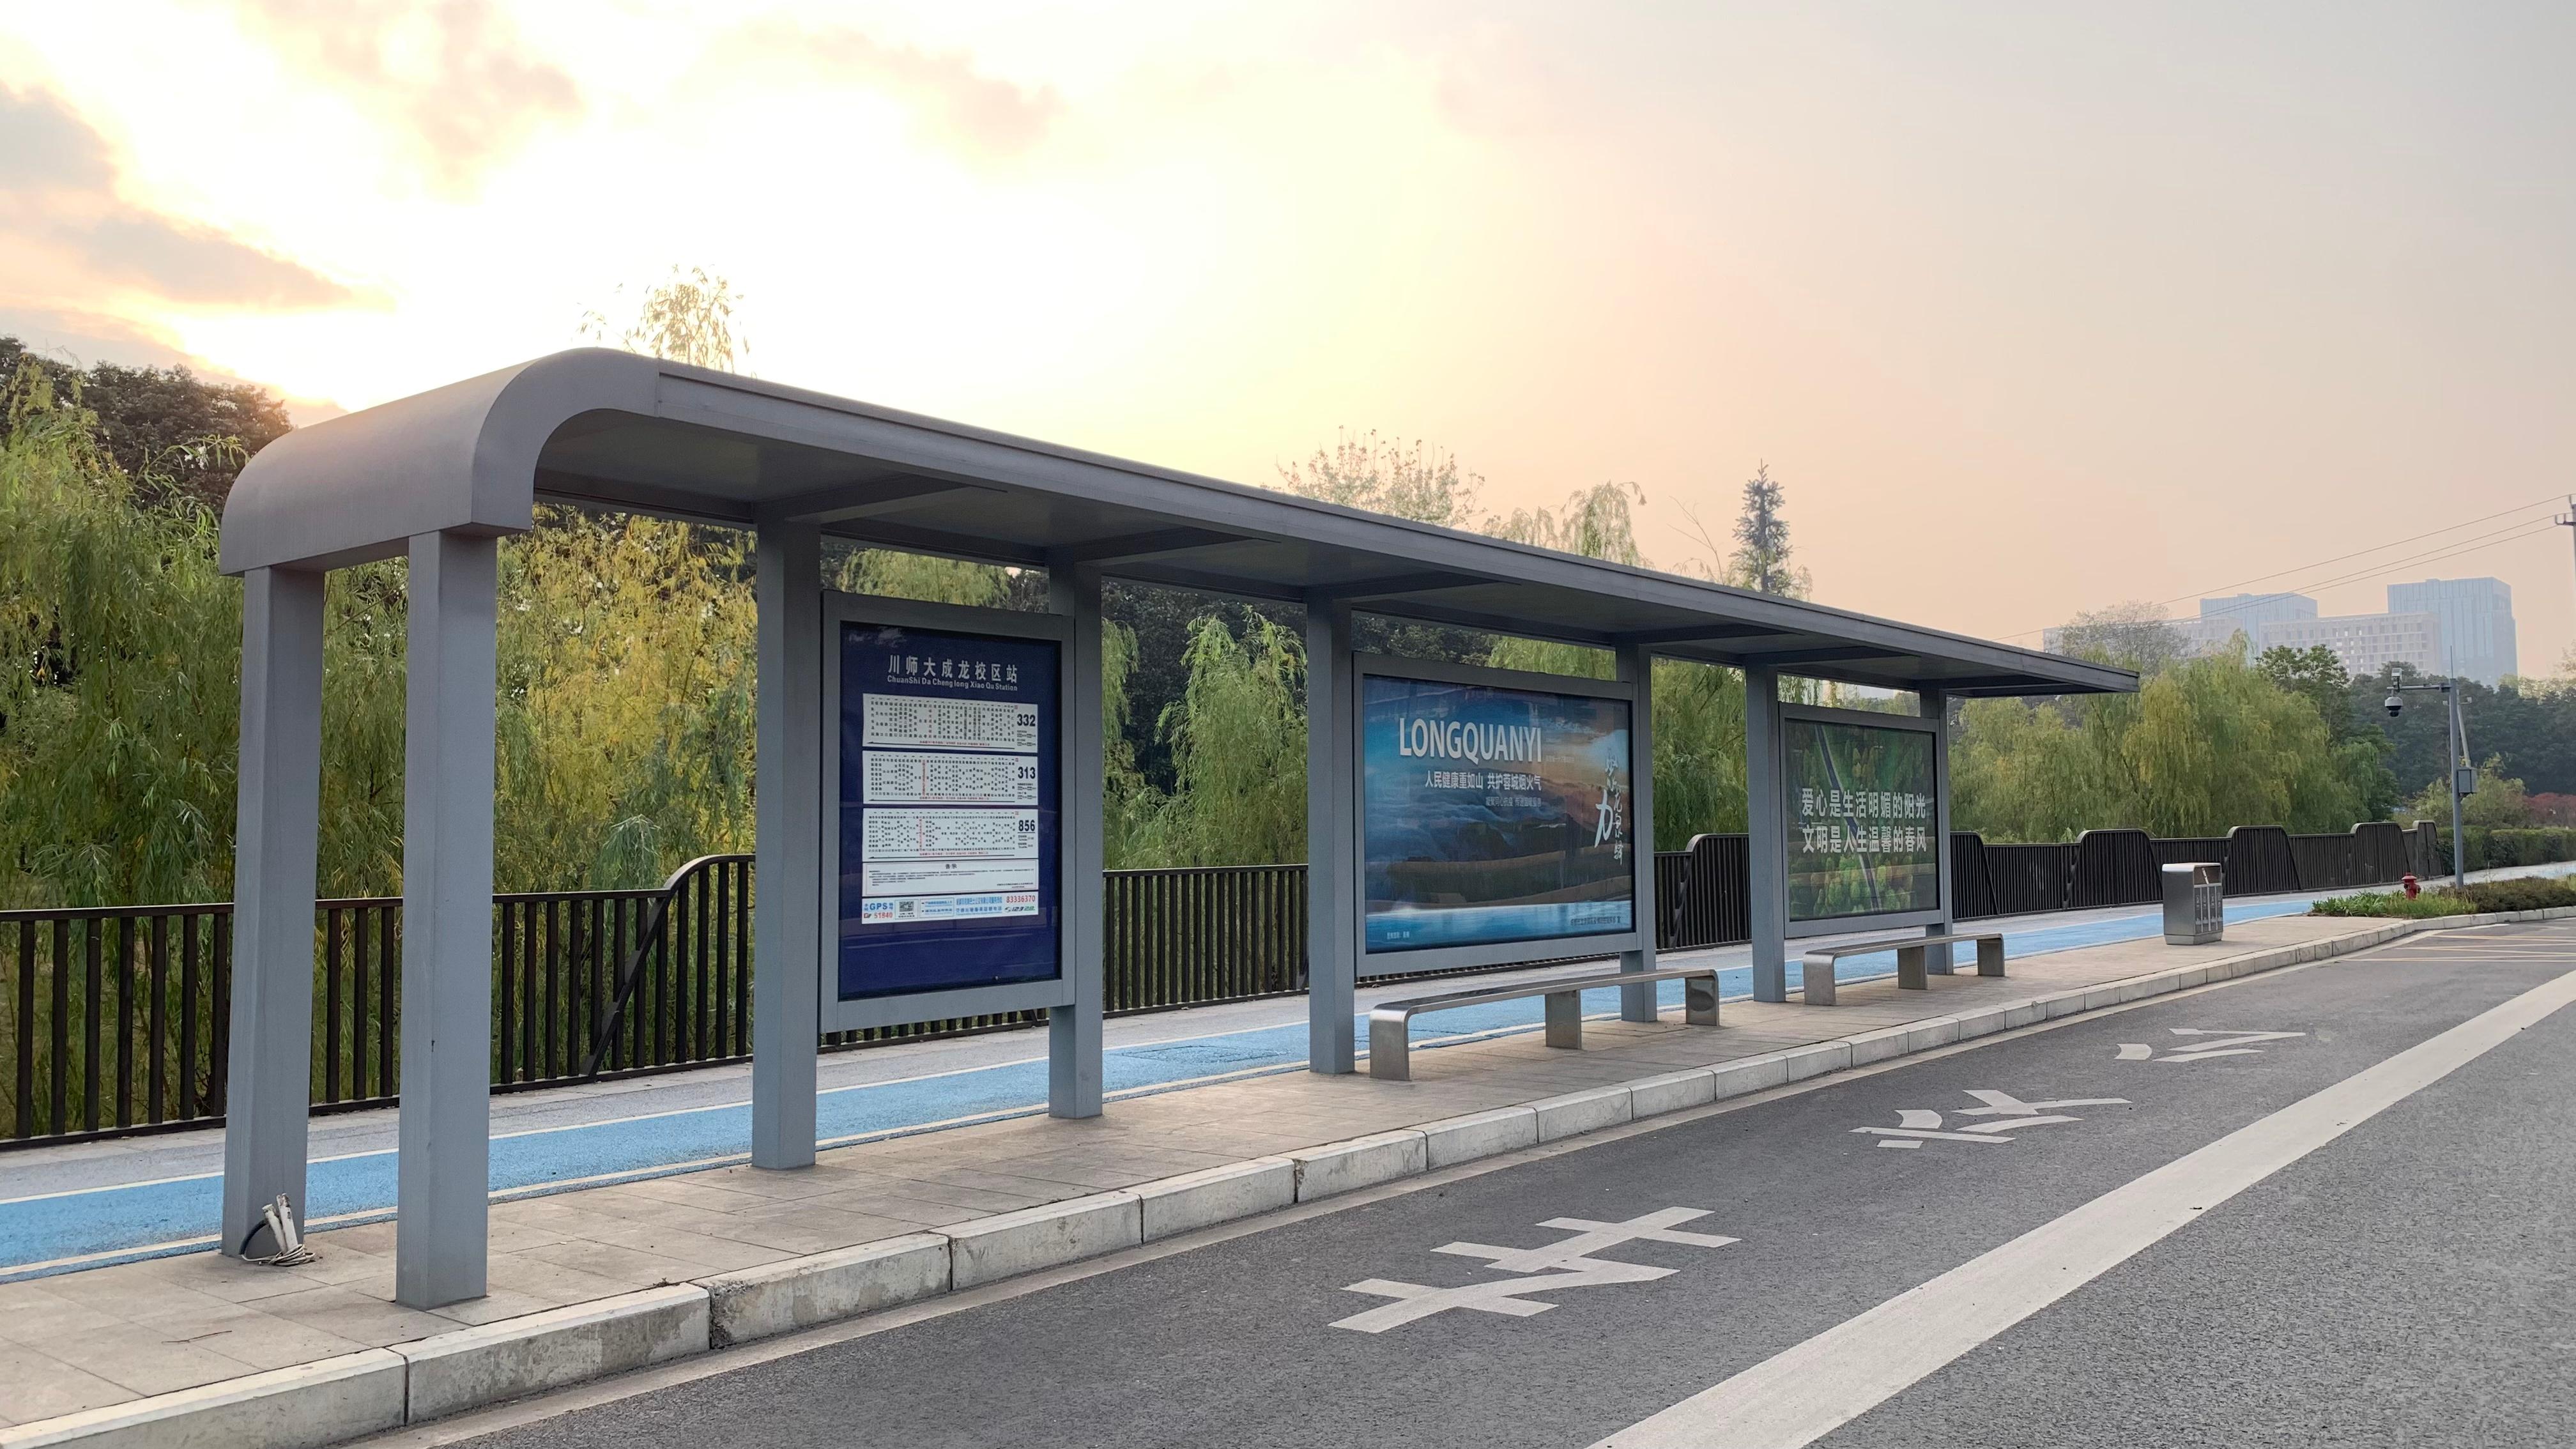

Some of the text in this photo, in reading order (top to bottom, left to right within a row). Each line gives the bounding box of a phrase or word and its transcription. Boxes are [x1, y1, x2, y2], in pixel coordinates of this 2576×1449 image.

[888, 655, 1017, 683] 川师大成龙校区站
[887, 675, 921, 685] ChuanShi
[995, 683, 1018, 691] Station
[1016, 714, 1036, 726] 332
[1399, 717, 1542, 765] LONGQUANYI
[1018, 767, 1036, 779] 313
[1425, 770, 1542, 791] 人民健康重如山 共护蓉城烟火气
[1802, 788, 1926, 819] 爱心是生活明媚的阳光
[1018, 820, 1035, 831] 856
[1802, 824, 1927, 854] 文明是人生温馨的春风
